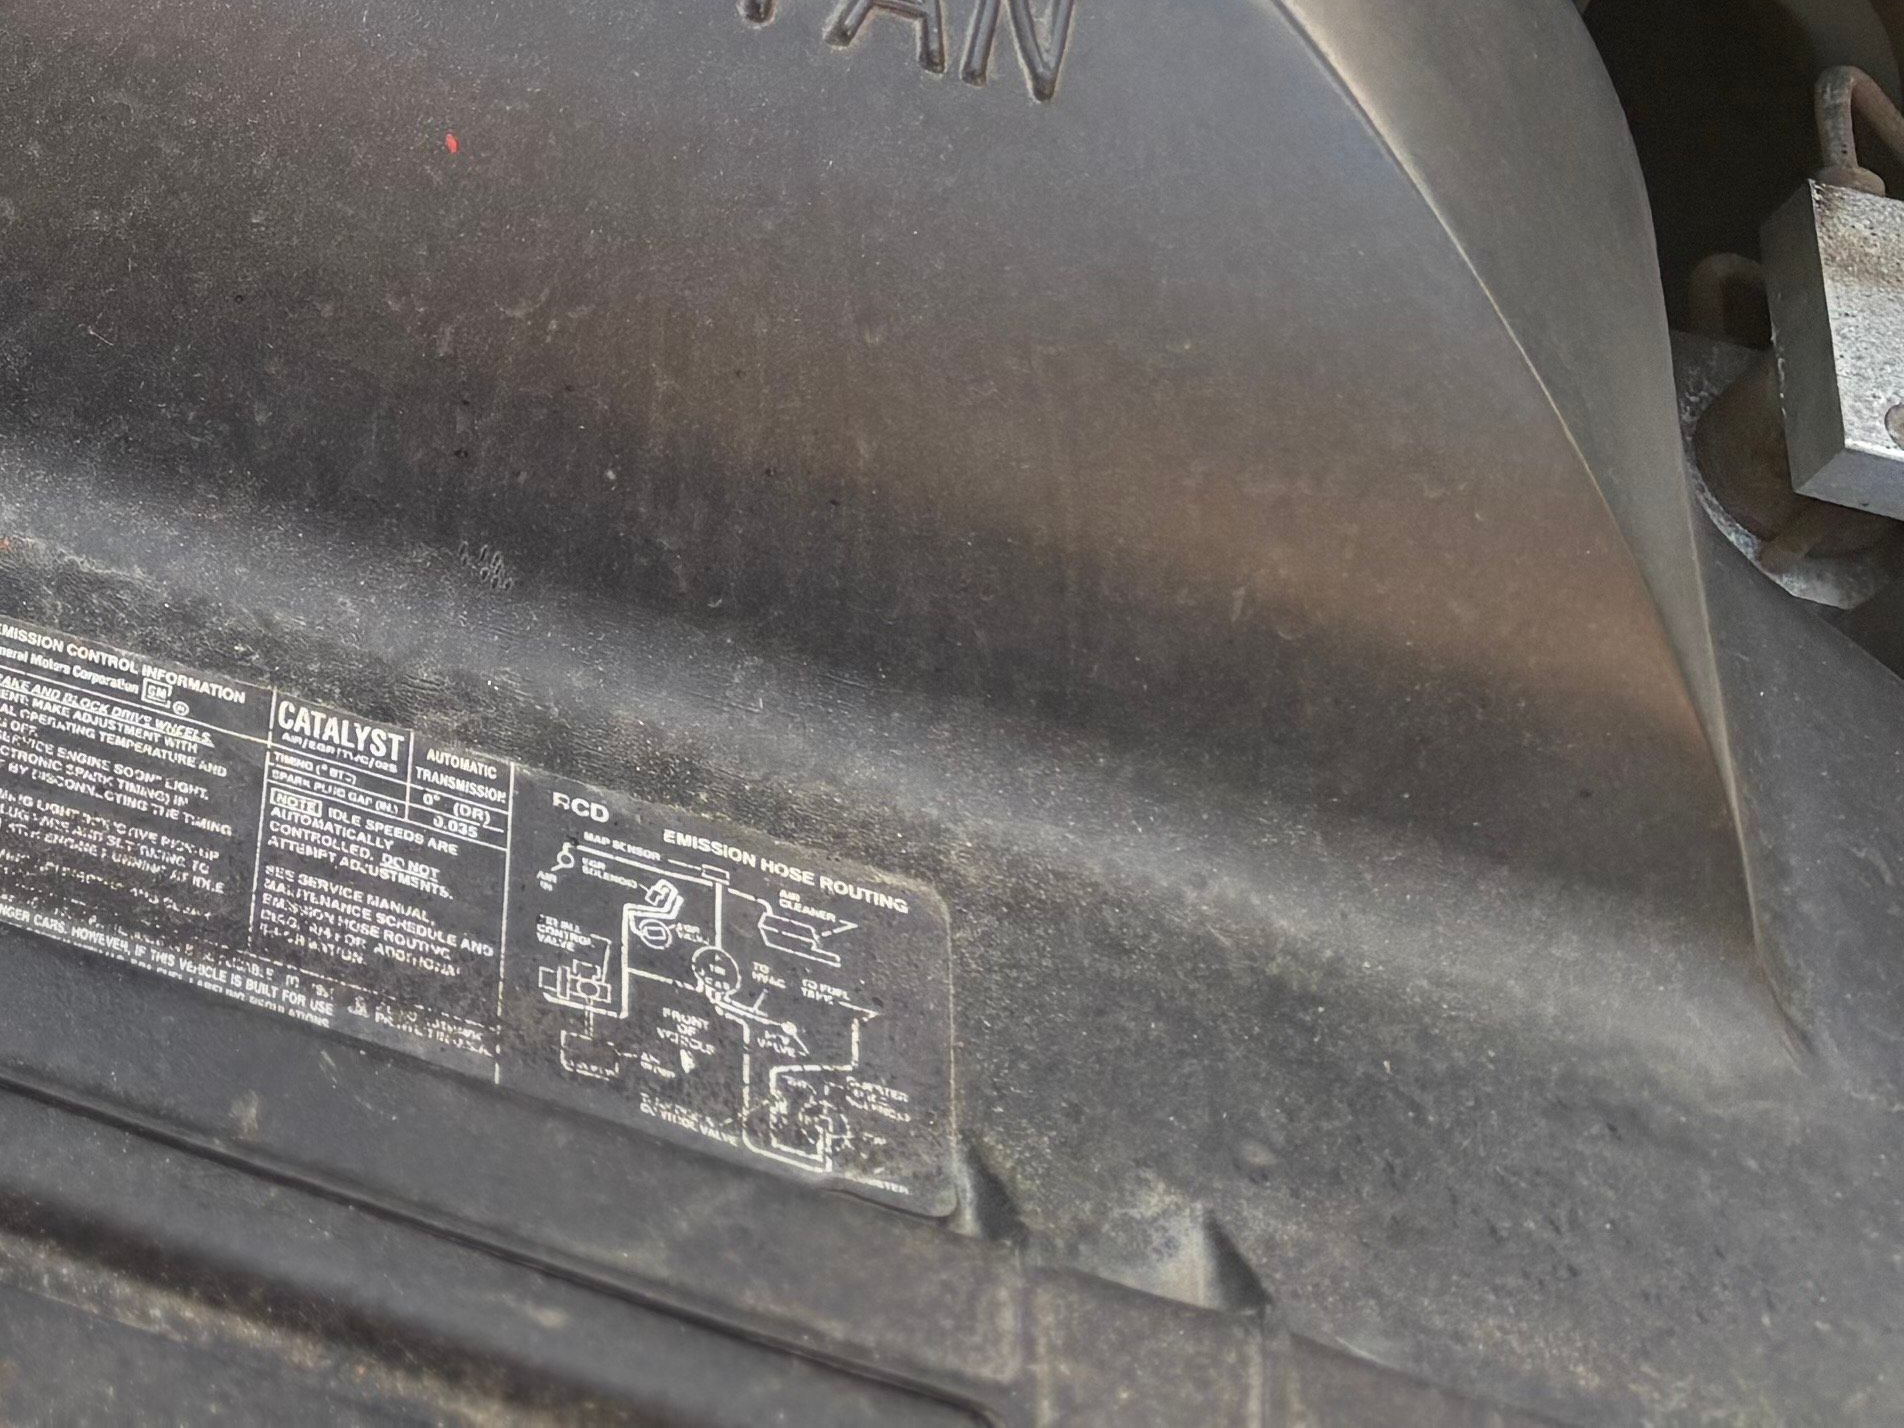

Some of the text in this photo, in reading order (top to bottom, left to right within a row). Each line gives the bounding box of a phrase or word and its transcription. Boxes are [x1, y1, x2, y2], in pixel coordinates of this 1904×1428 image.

[29, 653, 70, 675] Motors
[70, 664, 140, 696] Corporation
[65, 642, 140, 675] CONTROL
[140, 663, 247, 705] INFORMATION
[146, 684, 168, 700] GM
[30, 683, 60, 700] AND
[62, 692, 110, 714] BLOCK
[31, 697, 71, 718] MAKE
[72, 709, 160, 744] ADJUSTMENT
[160, 734, 198, 754] WITH
[273, 700, 405, 762] CATALYST
[7, 761, 28, 776] BY
[56, 746, 111, 772] ENGINE
[97, 730, 197, 769] TEMPERATURE
[198, 760, 227, 777] AND
[425, 747, 499, 780] AUTOMATIC
[412, 765, 507, 804] TRANSMISSION
[269, 805, 394, 851] AUTOMATICALLY
[274, 792, 459, 855] NOTE IDLE SPEEDS ARE
[431, 814, 479, 838] 0.035
[451, 801, 491, 825] (DR)
[405, 860, 439, 878] NOT
[548, 790, 910, 914] RCD EMISSION HOSE ROUTING
[297, 873, 364, 902] SERVICE
[373, 911, 458, 946] SCHEDULE
[459, 937, 495, 957] AND
[133, 945, 146, 957] IF
[147, 949, 175, 967] THIS
[177, 958, 228, 983] VEHICLE
[229, 973, 243, 987] IS
[244, 978, 278, 998] BUILT
[279, 988, 307, 1007] FOR
[307, 998, 335, 1016] USE
